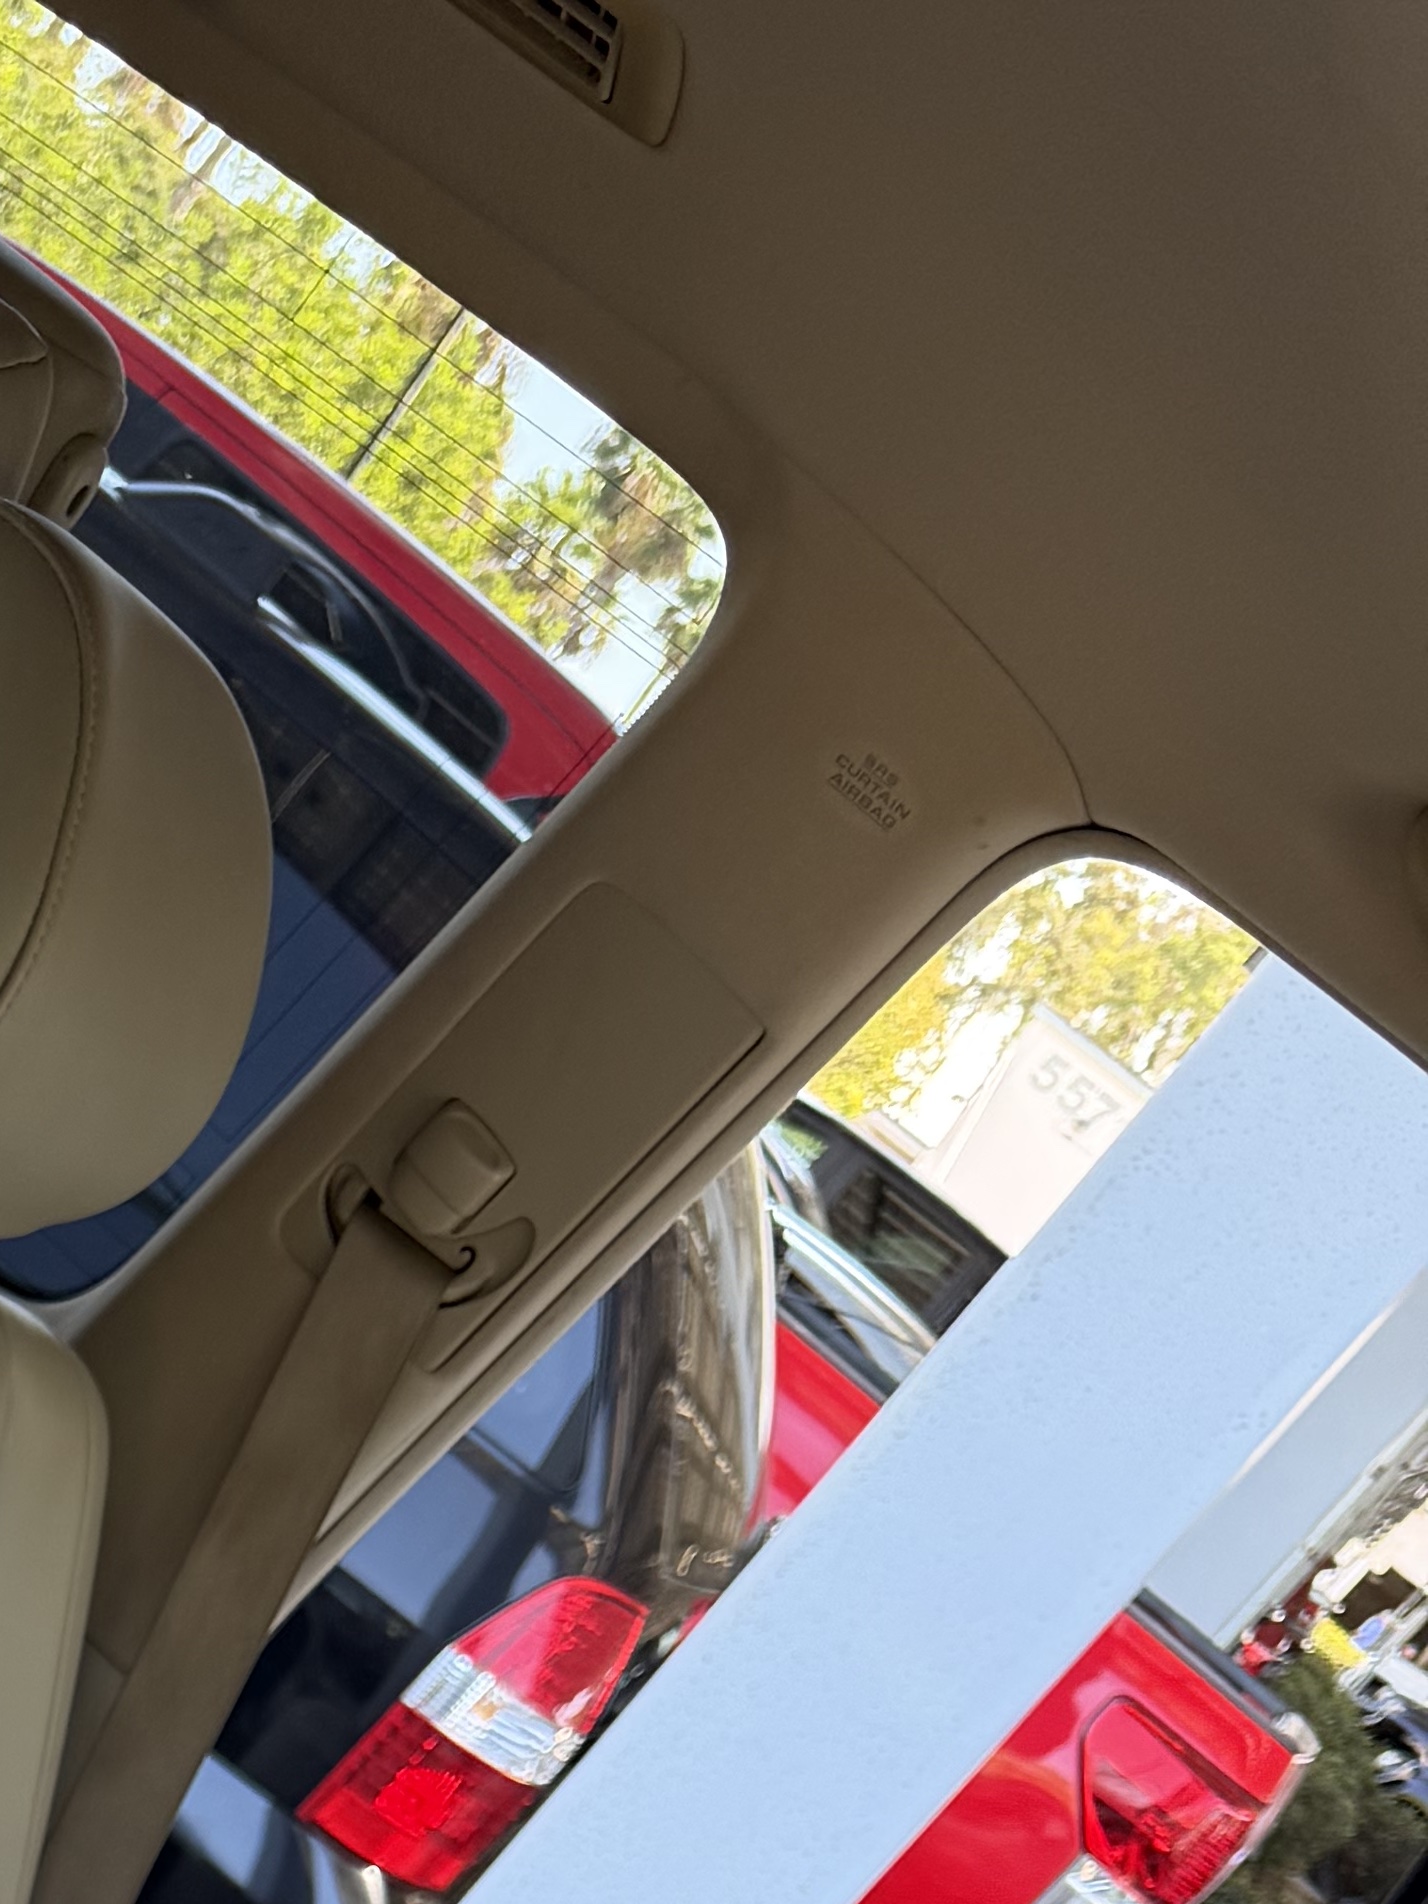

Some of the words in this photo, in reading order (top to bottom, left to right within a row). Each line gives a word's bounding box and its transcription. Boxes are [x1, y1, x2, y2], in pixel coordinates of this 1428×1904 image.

[828, 773, 897, 829] AIRBAG
[835, 753, 911, 820] CURTAIN
[1028, 1053, 1122, 1131] 557
